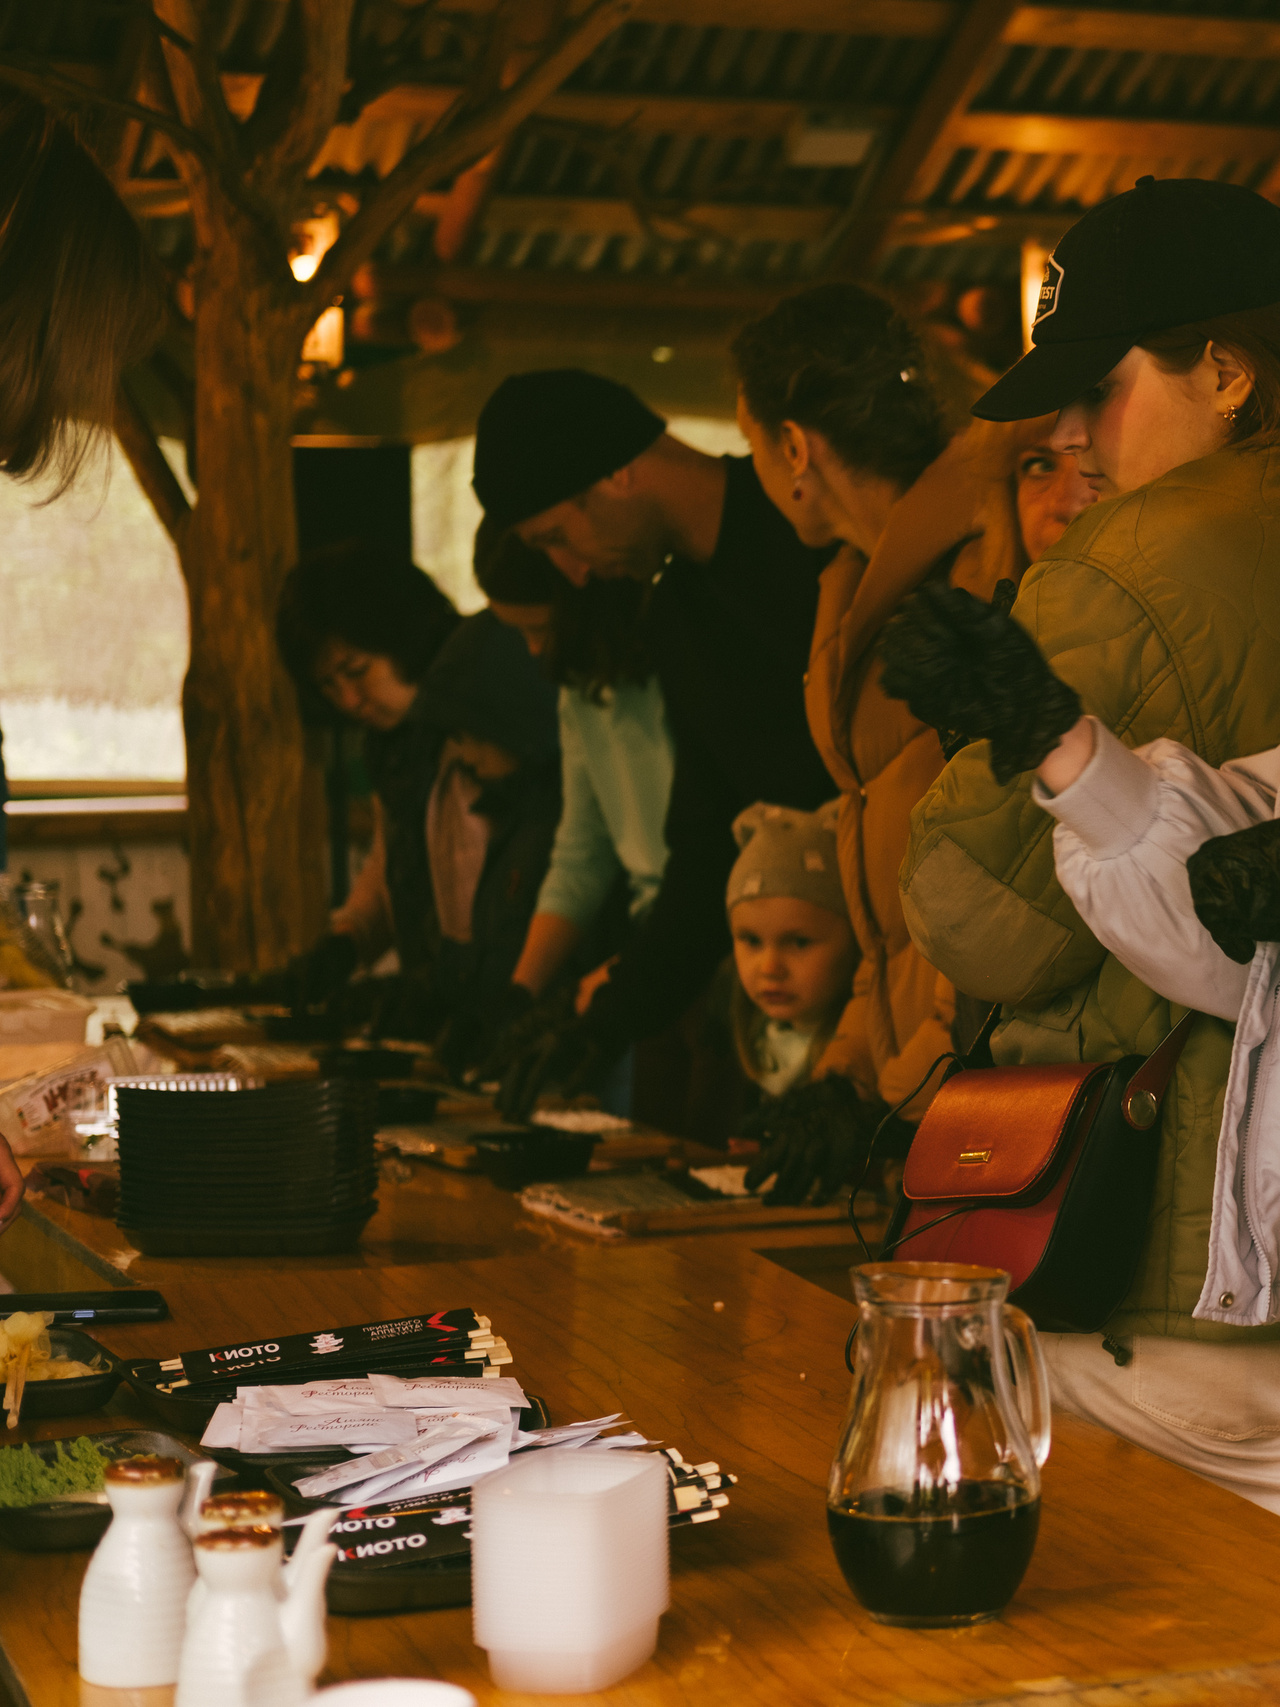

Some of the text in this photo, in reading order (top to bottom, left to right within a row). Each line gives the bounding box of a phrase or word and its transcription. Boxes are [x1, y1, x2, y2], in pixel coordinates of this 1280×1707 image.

[362, 1319, 421, 1332] ПРИЯТНОГО
[208, 1343, 280, 1363] КИОТО
[329, 1516, 396, 1533] ИОТО
[338, 1534, 427, 1561] КИОТО
